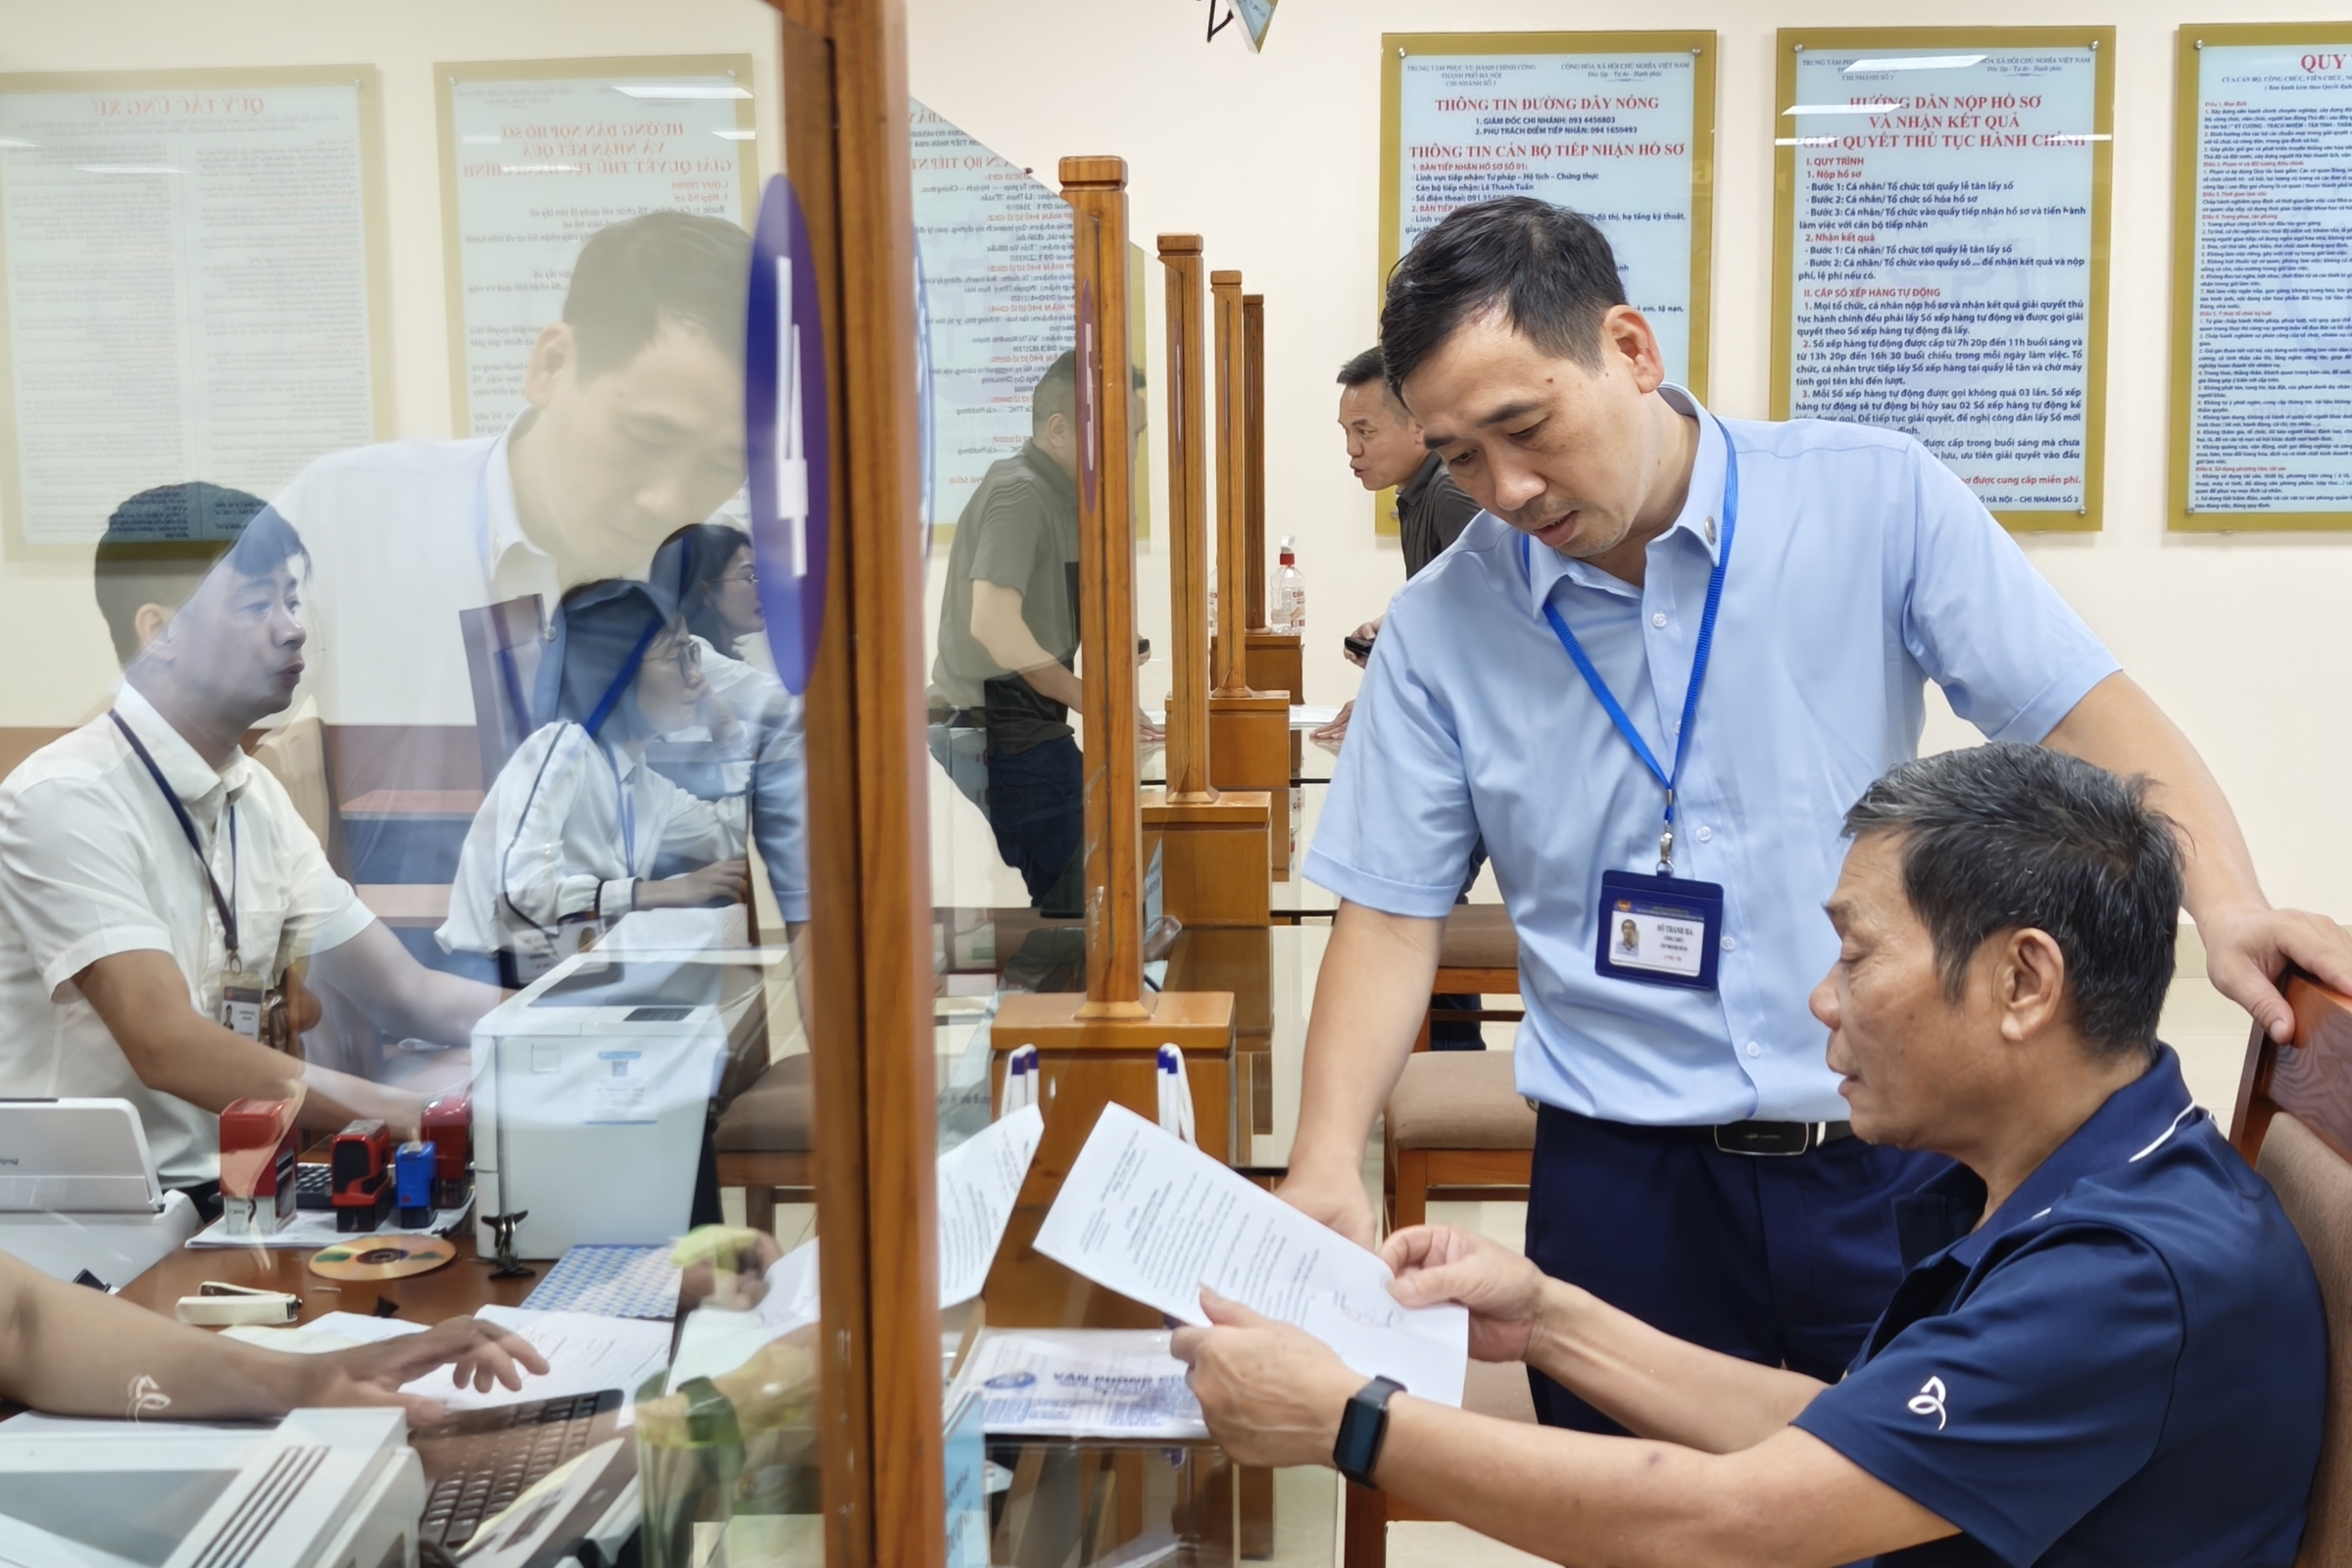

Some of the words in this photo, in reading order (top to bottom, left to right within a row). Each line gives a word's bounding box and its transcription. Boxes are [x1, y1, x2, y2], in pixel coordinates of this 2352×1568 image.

[2300, 54, 2346, 73] QUY
[1436, 96, 1489, 111] THÔNG
[1494, 98, 1517, 111] TIN
[1522, 96, 1577, 110] ĐƯỜNG
[1581, 94, 1612, 110] DÂY
[1615, 94, 1659, 109] NÓNG
[1849, 93, 1911, 110] HƯỚNG
[1915, 93, 1949, 109] DẪN
[1953, 94, 1987, 112] NỘP
[1990, 92, 2016, 109] HỒ
[2019, 94, 2041, 108] SƠ
[1504, 116, 1521, 124] ĐỐC
[1537, 116, 1567, 125] NHÁNH:
[1568, 117, 1583, 125] 093
[1869, 112, 1891, 129] VÀ
[1895, 115, 1942, 130] NHẬN
[1947, 112, 1982, 128] KẾT
[1984, 112, 2019, 130] QUẢ
[1526, 125, 1546, 134] ĐIỂM
[1547, 125, 1563, 134] TIẾP
[1842, 133, 1899, 151] QUYẾT
[1901, 132, 1937, 148] THỦ
[1940, 134, 1976, 150] TỤC
[1980, 131, 2027, 147] HÀNH
[2031, 131, 2085, 147] CHÍNH
[1410, 143, 1462, 158] THÔNG
[1468, 145, 1492, 158] TIN
[1494, 141, 1527, 157] CÁN
[1531, 143, 1551, 160] BỘ
[1556, 141, 1590, 157] TIẾP
[1592, 143, 1635, 159] NHẬN
[1638, 142, 1661, 156] HỒ
[1663, 142, 1685, 155] SƠ
[1438, 162, 1453, 171] TIẾP
[1478, 162, 1491, 171] HỒ
[1503, 161, 1515, 171] SỐ
[1805, 157, 1813, 166] I.
[1813, 157, 1834, 167] QUY
[1837, 157, 1864, 166] TRÌNH
[1447, 173, 1463, 182] tiếp
[1522, 172, 1534, 181] Hộ
[1555, 172, 1582, 181] Chứng
[1582, 172, 1599, 180] thực
[1816, 170, 1836, 180] Nộp
[1837, 169, 1849, 178] hồ
[1442, 183, 1457, 192] tiếp
[1811, 182, 1834, 191] Bước
[1837, 182, 1844, 191] 1:
[1845, 182, 1857, 191] Cá
[1858, 181, 1886, 190] nhân/
[1886, 180, 1898, 191] Tổ
[1899, 182, 1920, 191] chức
[1922, 181, 1935, 190] tới
[1936, 181, 1959, 192] quầy
[1960, 180, 1969, 190] lễ
[1987, 180, 2001, 192] lấy
[2003, 180, 2014, 190] số
[1814, 287, 1833, 297] CẤP
[1835, 287, 1847, 298] SỐ
[1849, 287, 1866, 297] XẾP
[1868, 288, 1896, 297] HÀNG
[1897, 287, 1911, 298] TỰ
[1912, 286, 1940, 298] ĐỘNG
[1816, 376, 1831, 387] gọi
[1832, 376, 1847, 385] tên
[1848, 376, 1864, 385] khi
[1865, 376, 1883, 385] đến
[1884, 376, 1908, 385] lượt.
[1972, 475, 1995, 484] được
[2021, 475, 2036, 485] cấp
[2038, 474, 2062, 483] miễn
[2062, 475, 2082, 485] phí.
